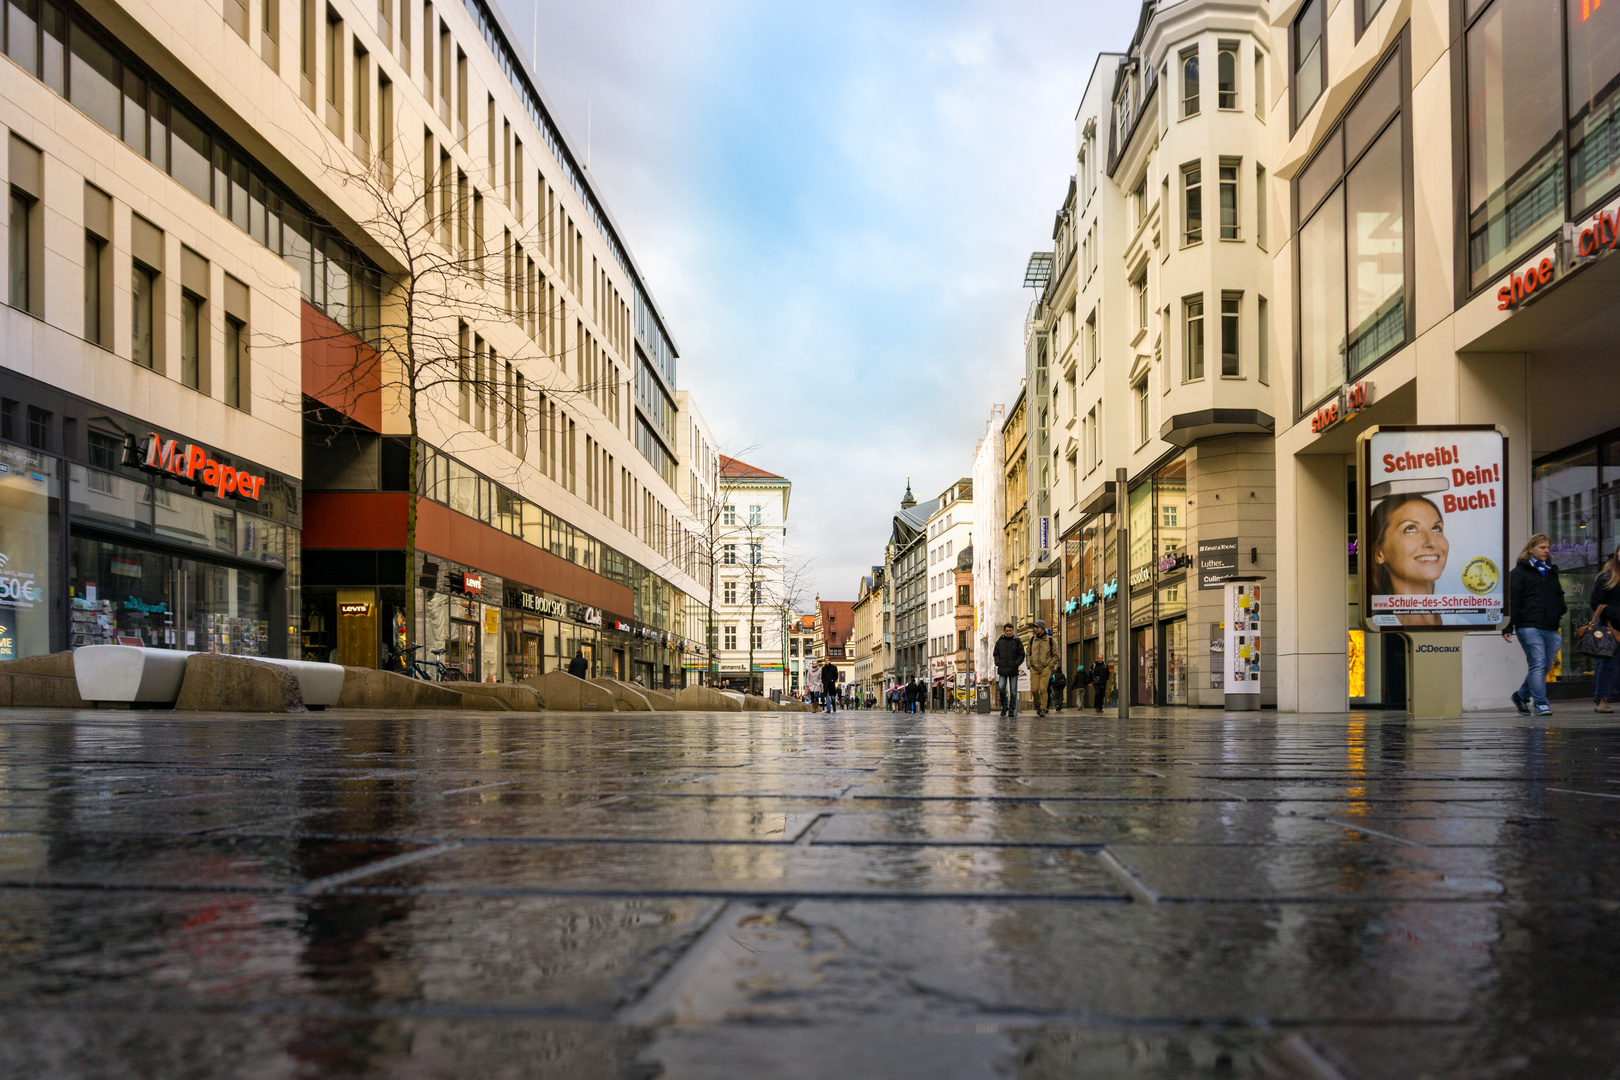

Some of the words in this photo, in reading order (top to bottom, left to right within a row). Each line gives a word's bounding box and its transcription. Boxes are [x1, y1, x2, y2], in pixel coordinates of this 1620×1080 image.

[1498, 257, 1551, 311] shoe
[1579, 206, 1620, 257] city
[1312, 404, 1338, 434] shoe
[1349, 381, 1368, 409] city
[148, 432, 265, 500] McPaper
[1383, 444, 1460, 473] Schreib!
[1452, 463, 1500, 487] Dein!
[1443, 488, 1496, 513] Buch!
[1572, 583, 1585, 594] city
[521, 591, 534, 610] THE
[535, 596, 552, 613] BODY
[552, 600, 567, 617] SHOP
[1374, 596, 1501, 608] www.Schule-des-Schreibens.de
[1415, 644, 1460, 653] JCDecaux
